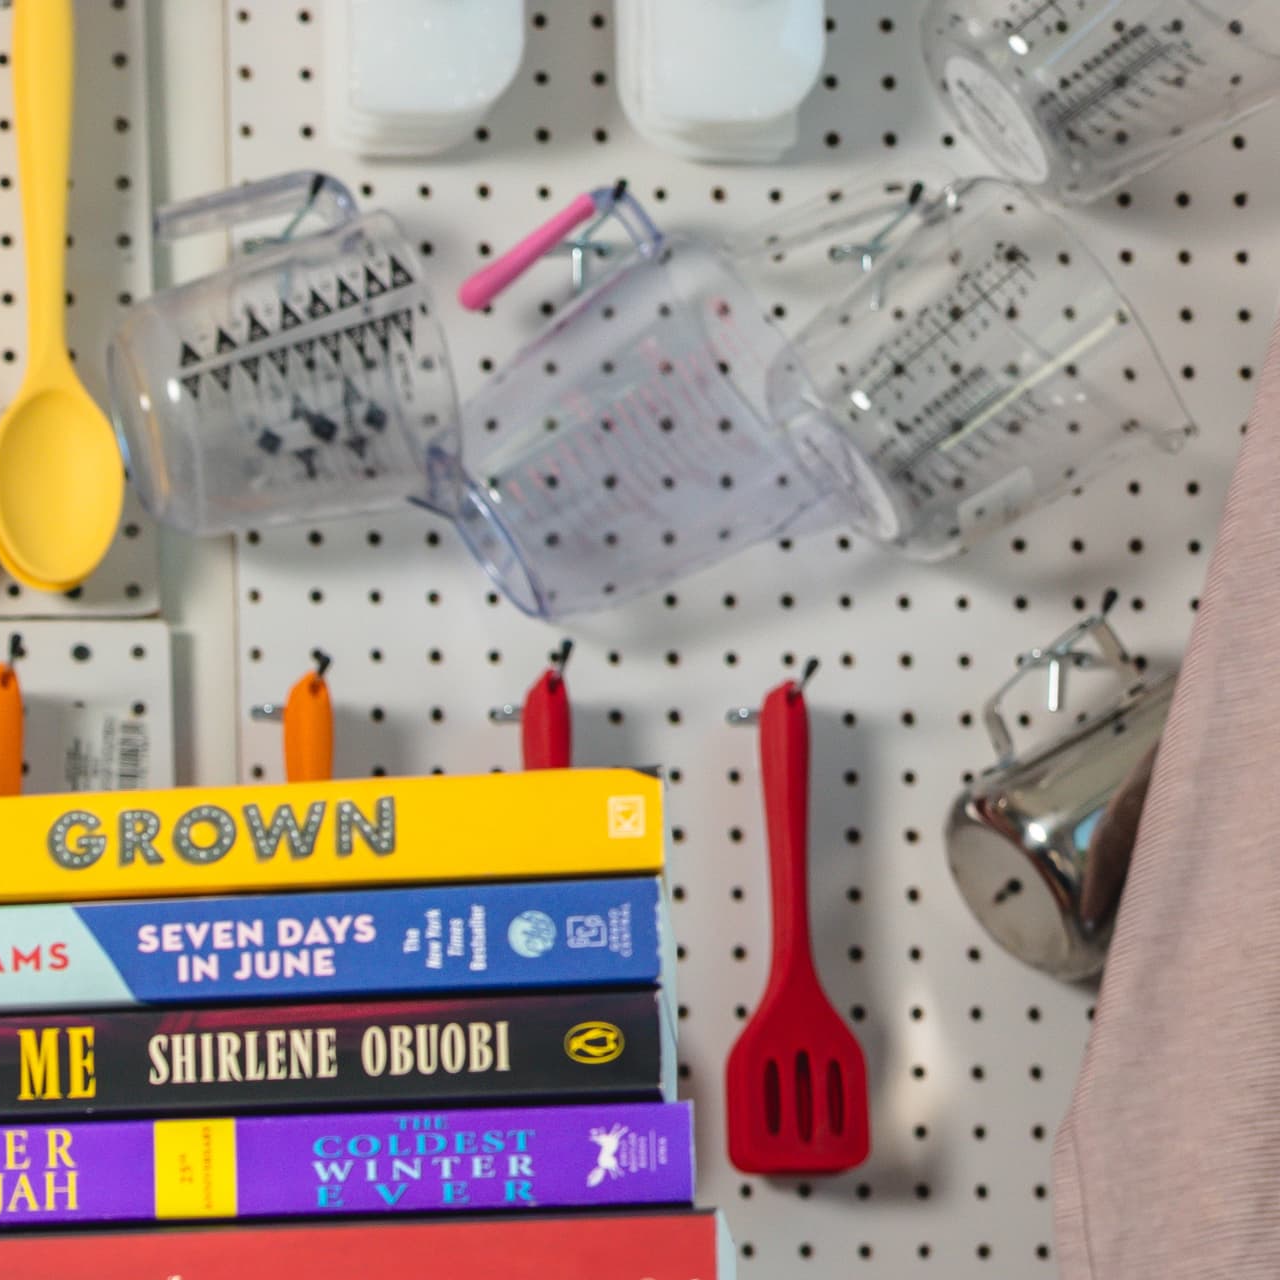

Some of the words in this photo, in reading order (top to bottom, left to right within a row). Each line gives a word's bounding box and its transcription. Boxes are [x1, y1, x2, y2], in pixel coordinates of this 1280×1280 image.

[47, 796, 396, 871] GROWN
[137, 918, 263, 953] SEVEN
[277, 914, 377, 947] DAYS
[424, 908, 442, 939] York
[447, 917, 465, 957] Times
[468, 903, 487, 971] Bestseller
[403, 928, 421, 954] The
[425, 939, 443, 970] New
[177, 953, 219, 984] IN
[233, 949, 336, 979] JUNE
[17, 1025, 97, 1102] ME
[148, 1027, 338, 1086] SHIRLENE
[360, 1021, 512, 1077] OBUOBI
[395, 1116, 449, 1131] THE
[311, 1129, 537, 1159] COLDEST
[311, 1154, 537, 1183] WINTER
[316, 1179, 537, 1209] EVER
